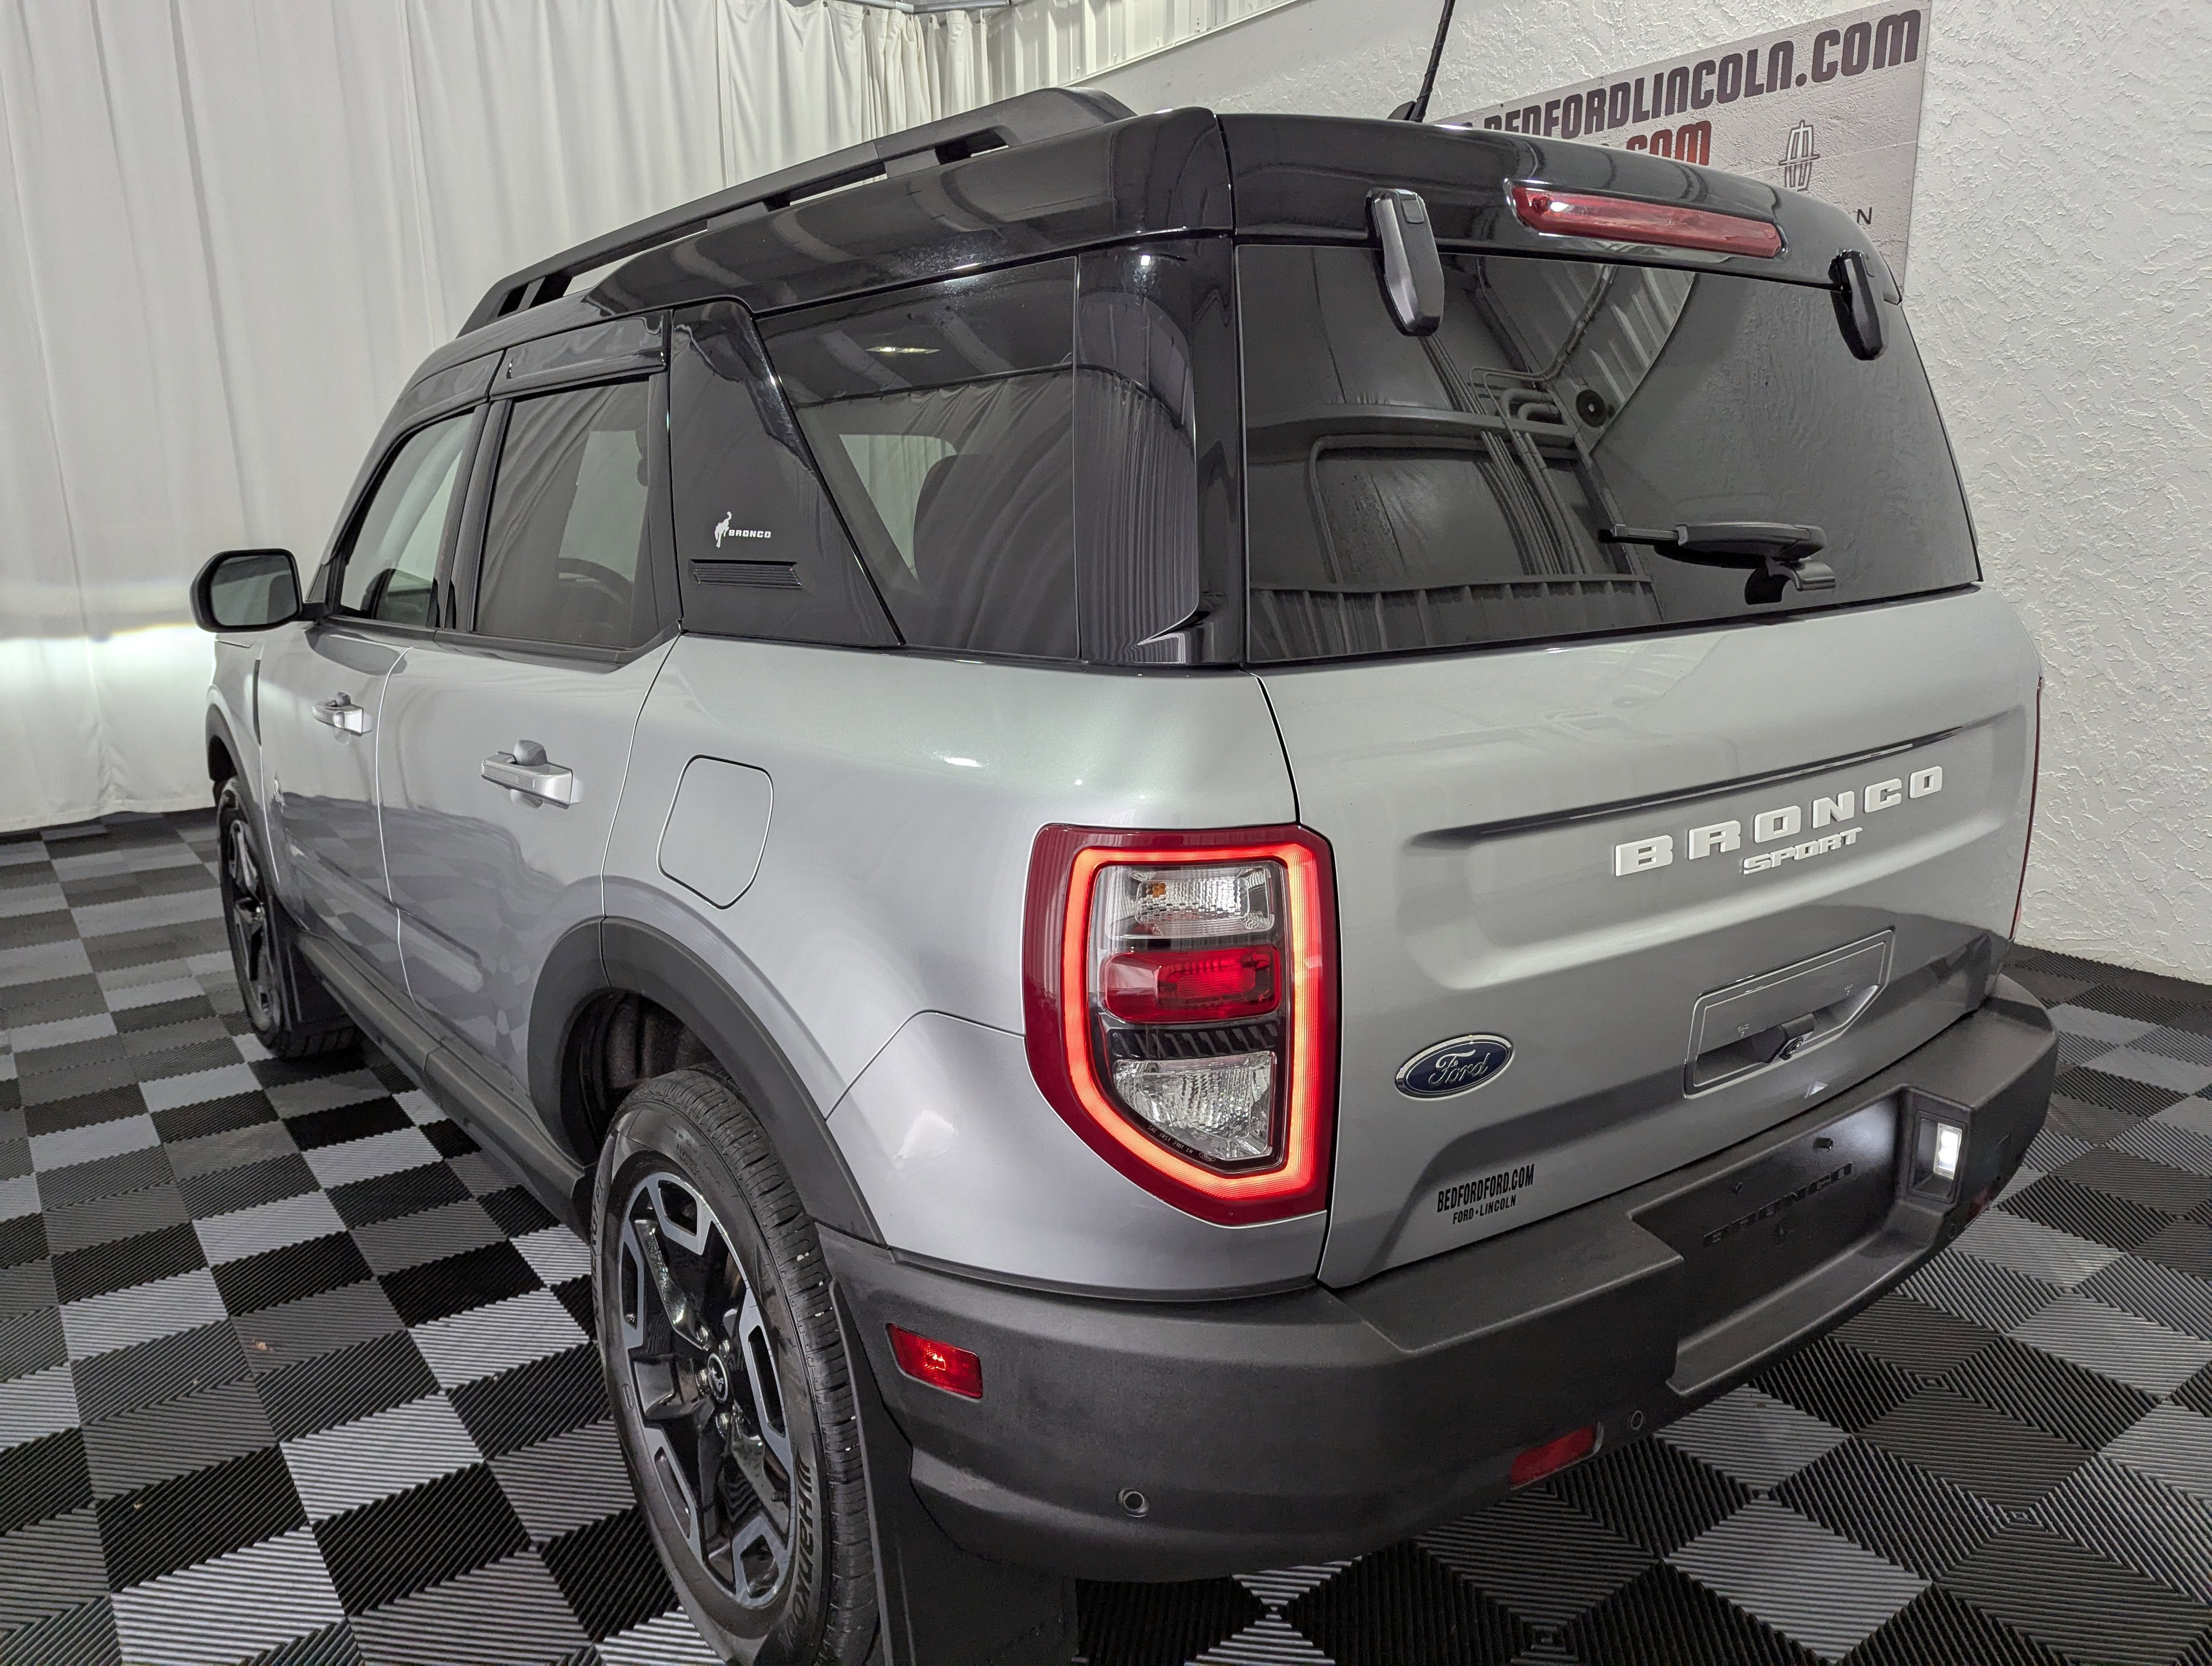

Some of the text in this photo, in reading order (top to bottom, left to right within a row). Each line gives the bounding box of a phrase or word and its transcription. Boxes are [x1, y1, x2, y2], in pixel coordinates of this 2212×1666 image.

[729, 529, 771, 539] BRONCO
[1614, 765, 1943, 877] BRONCO
[1742, 827, 1863, 874] SPORT
[1428, 1049, 1490, 1084] Ford
[1147, 1125, 1158, 1133] SAE
[1437, 1164, 1535, 1213] BEDFORDFORD.COM
